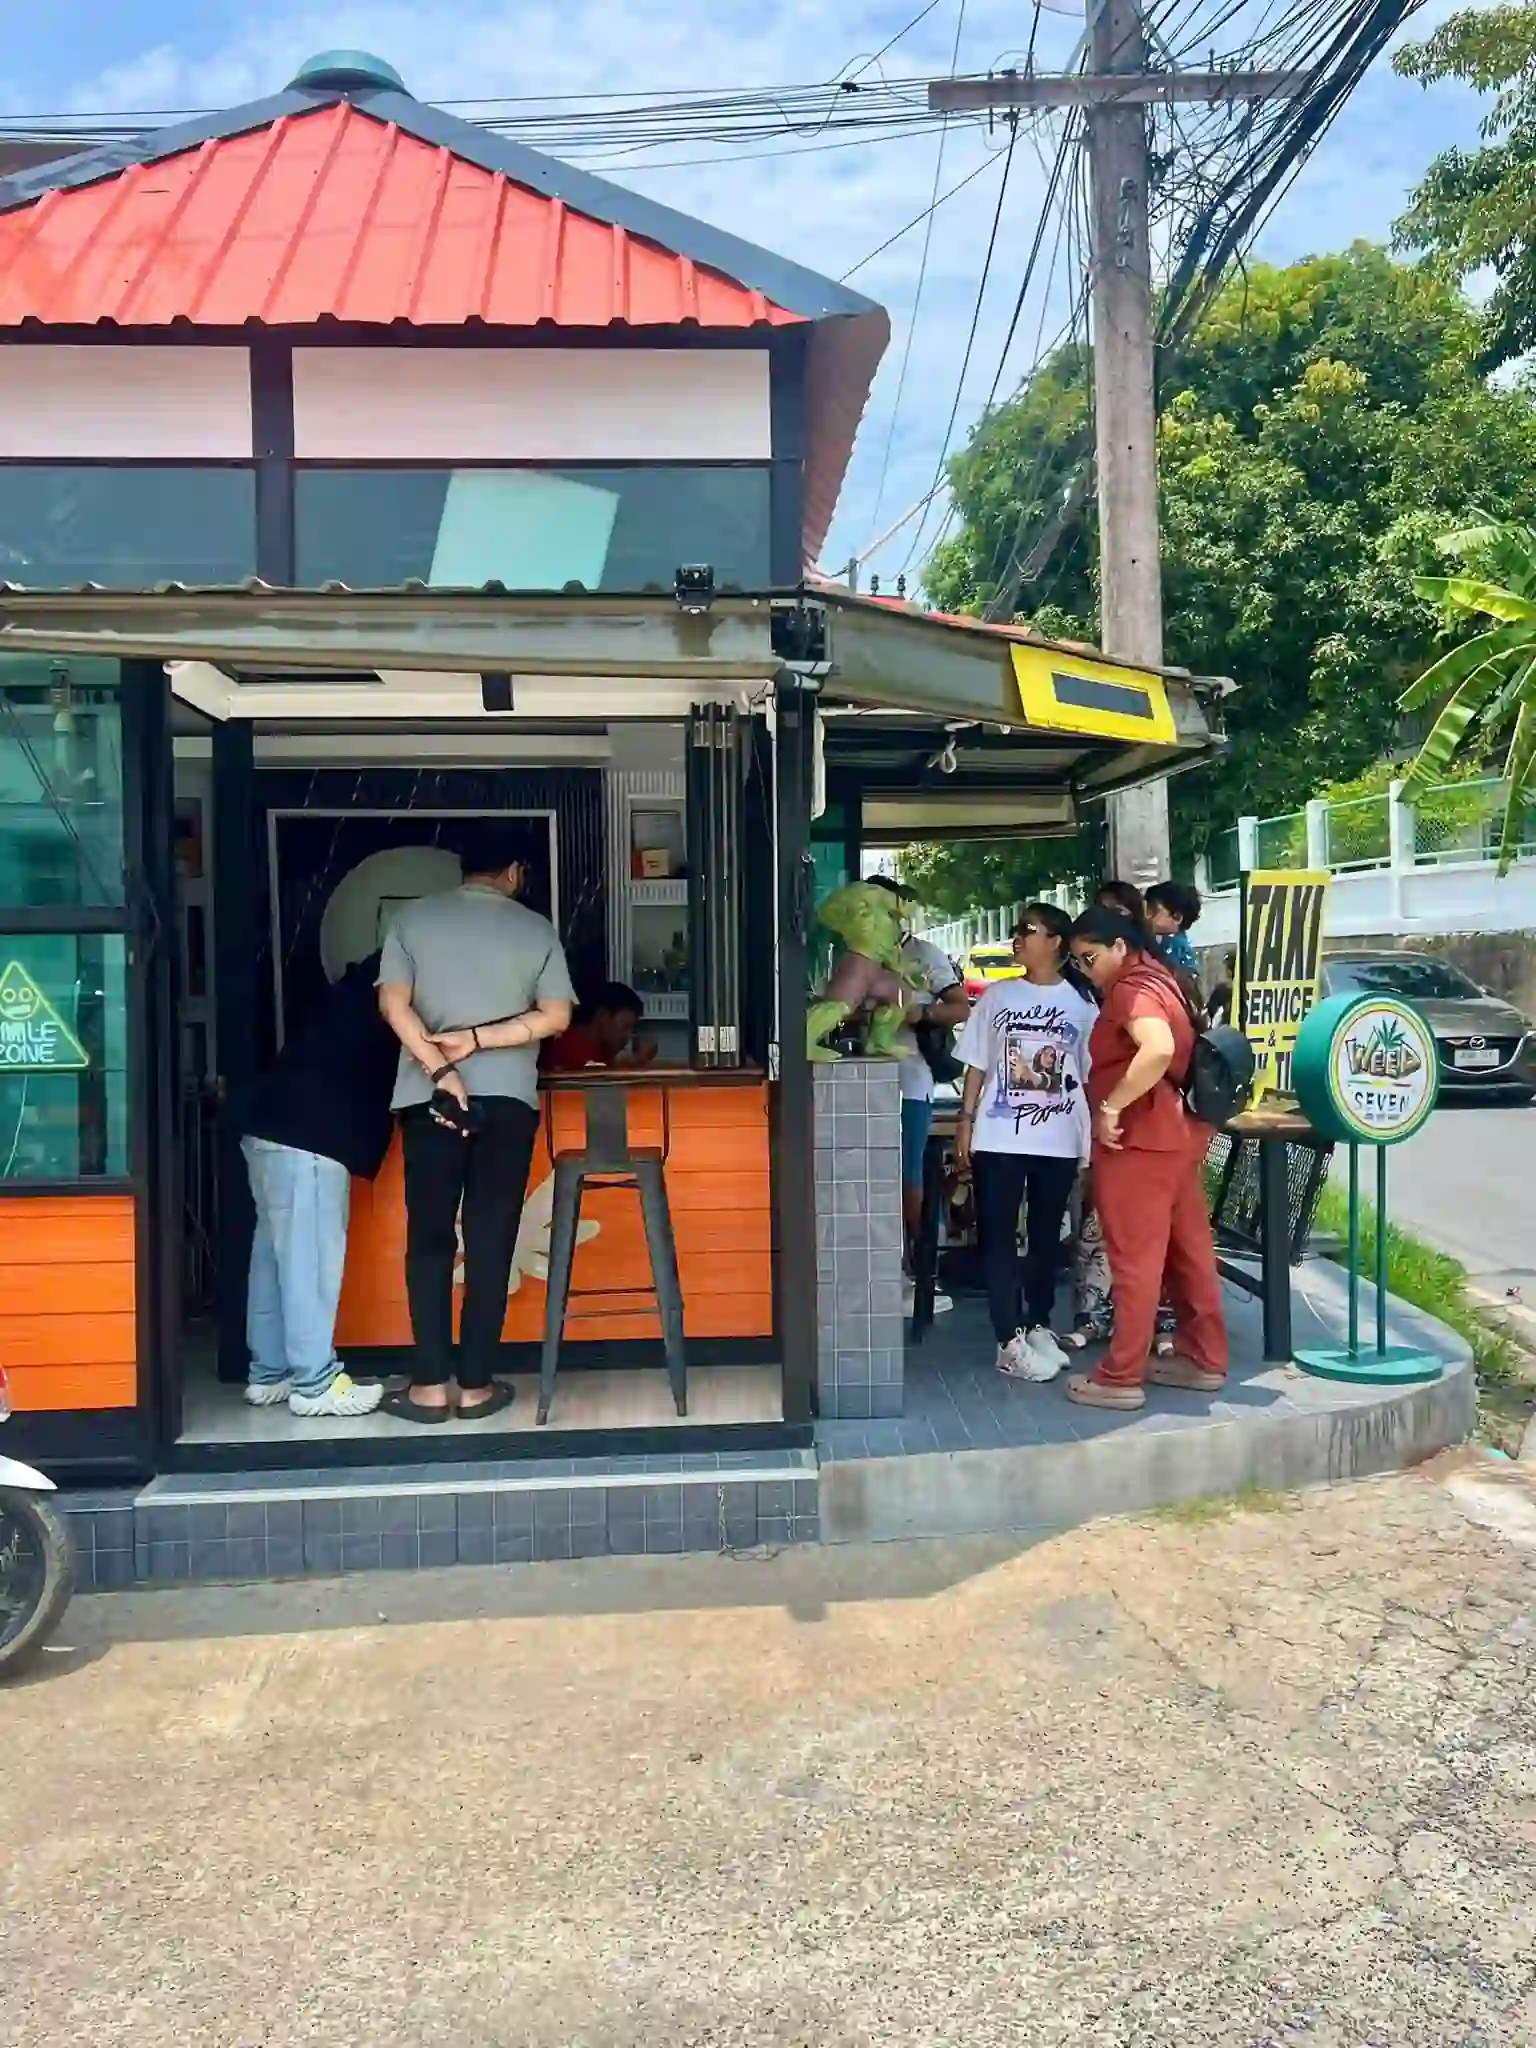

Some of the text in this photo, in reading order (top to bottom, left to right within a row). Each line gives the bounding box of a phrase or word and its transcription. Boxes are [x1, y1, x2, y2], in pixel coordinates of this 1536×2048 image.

[1246, 885, 1325, 981] TAXI
[0, 1020, 57, 1043] MILE
[1354, 1091, 1410, 1113] SEVEN
